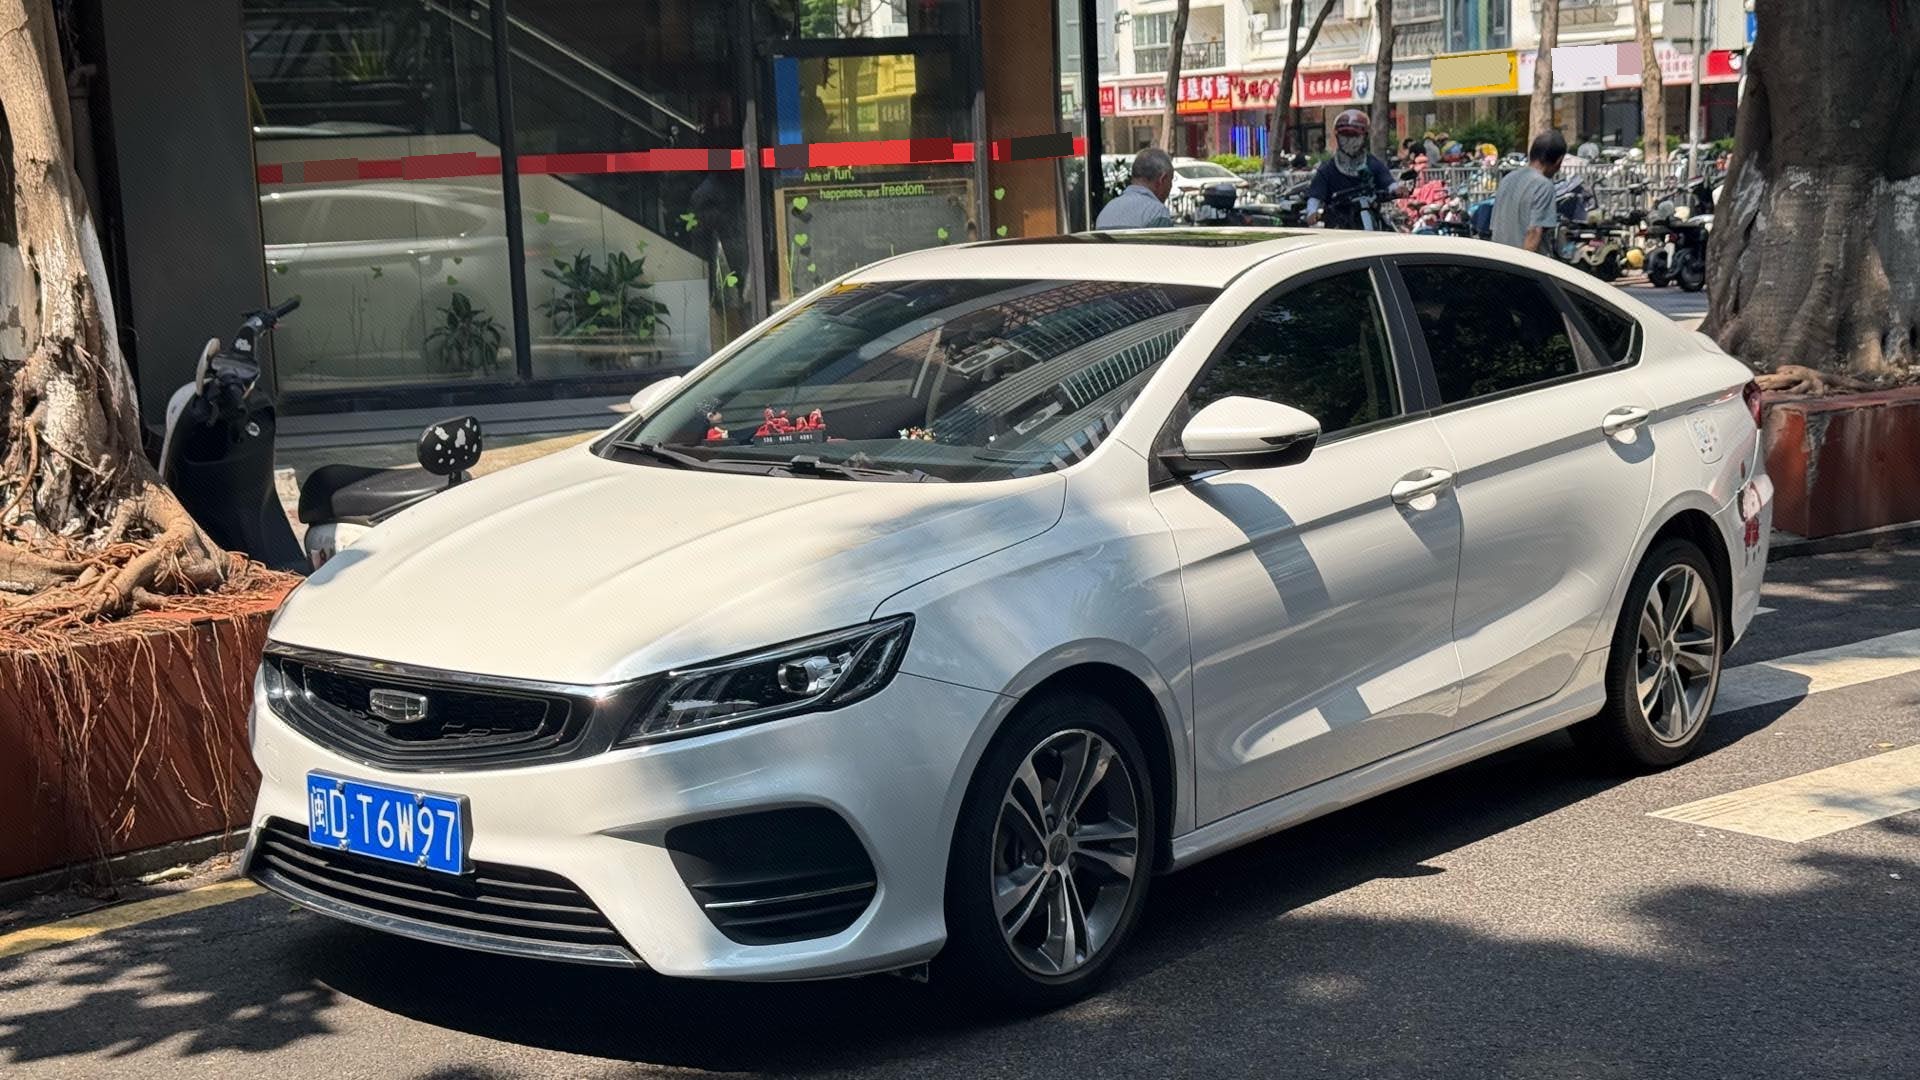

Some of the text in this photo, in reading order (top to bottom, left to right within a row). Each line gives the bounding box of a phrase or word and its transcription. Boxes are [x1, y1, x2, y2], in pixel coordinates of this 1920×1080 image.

[803, 168, 855, 183] A life of fun,
[820, 188, 866, 200] happiness,
[867, 190, 879, 198] and
